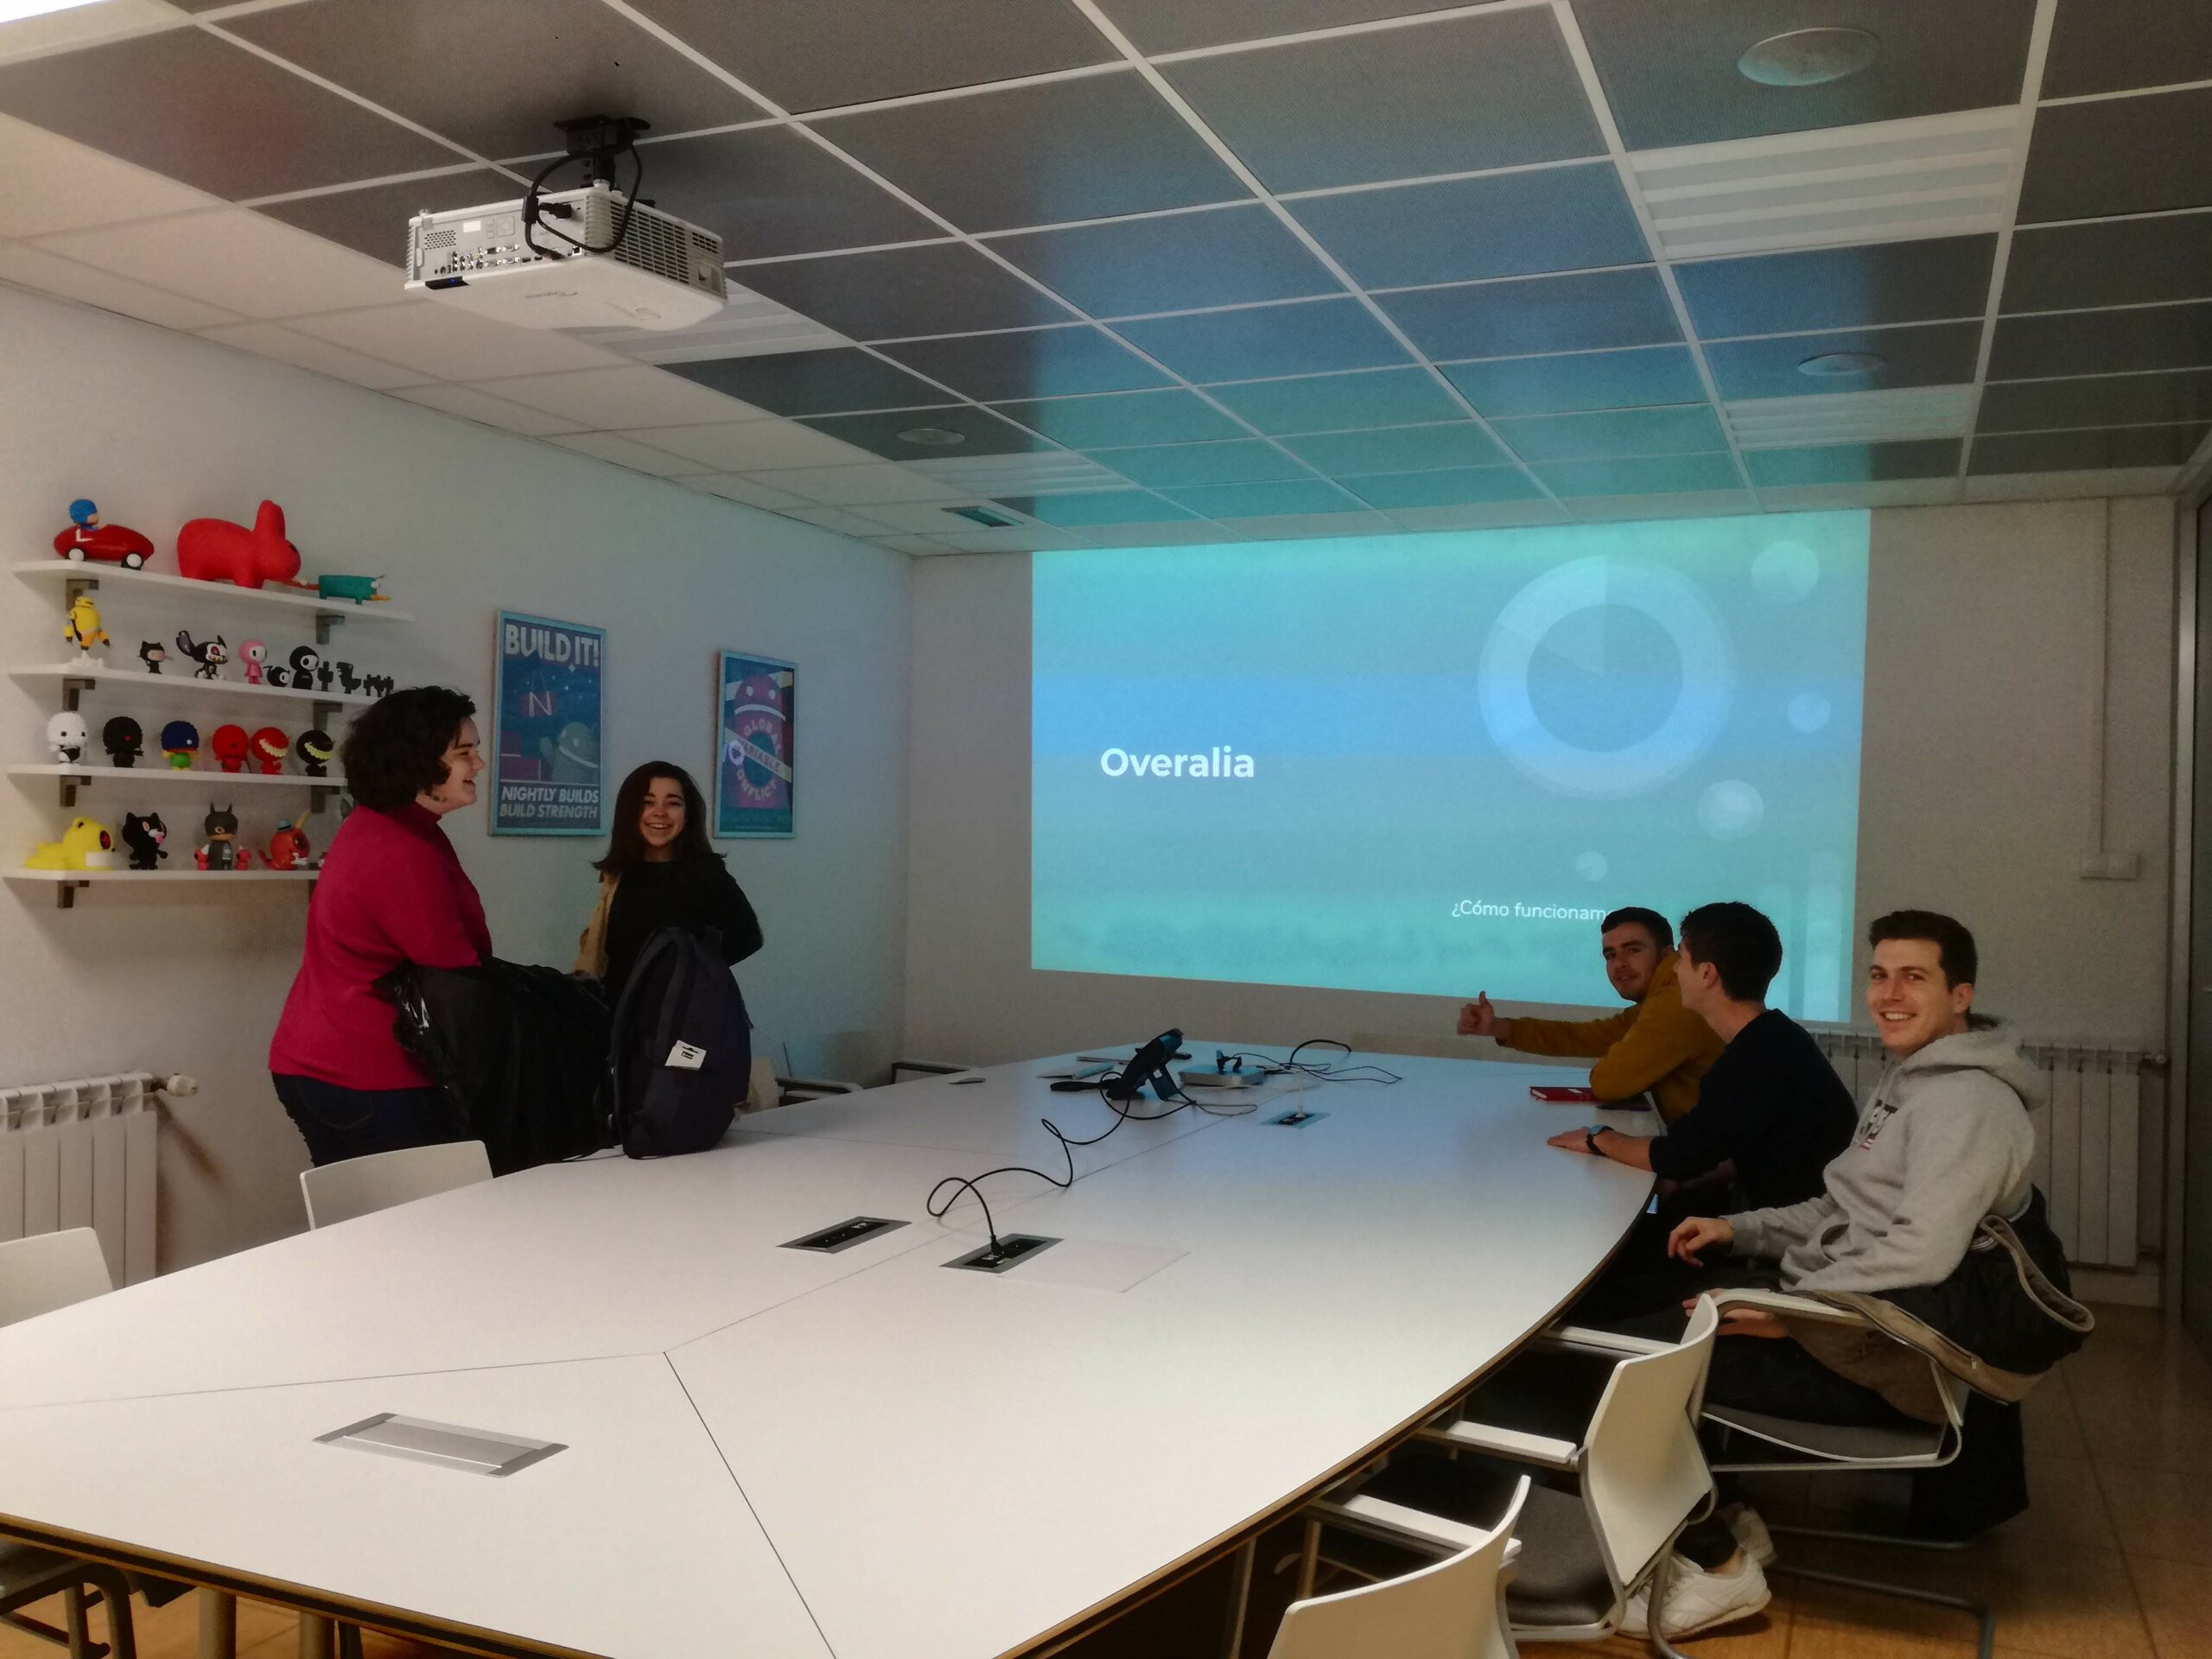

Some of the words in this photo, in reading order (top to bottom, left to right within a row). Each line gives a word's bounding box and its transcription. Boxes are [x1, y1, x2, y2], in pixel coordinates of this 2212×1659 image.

[505, 623, 572, 663] BUILD
[574, 635, 600, 668] IT!
[528, 690, 553, 718] N
[1100, 745, 1255, 778] Overalia
[501, 785, 556, 802] NIGHTLY
[557, 788, 600, 804] BUILDS
[736, 768, 777, 801] ONFLICT
[499, 803, 535, 817] BUILD
[537, 804, 598, 819] STRENGTH
[1452, 899, 1510, 918] ¿Cómo
[1514, 902, 1612, 921] funcionam
